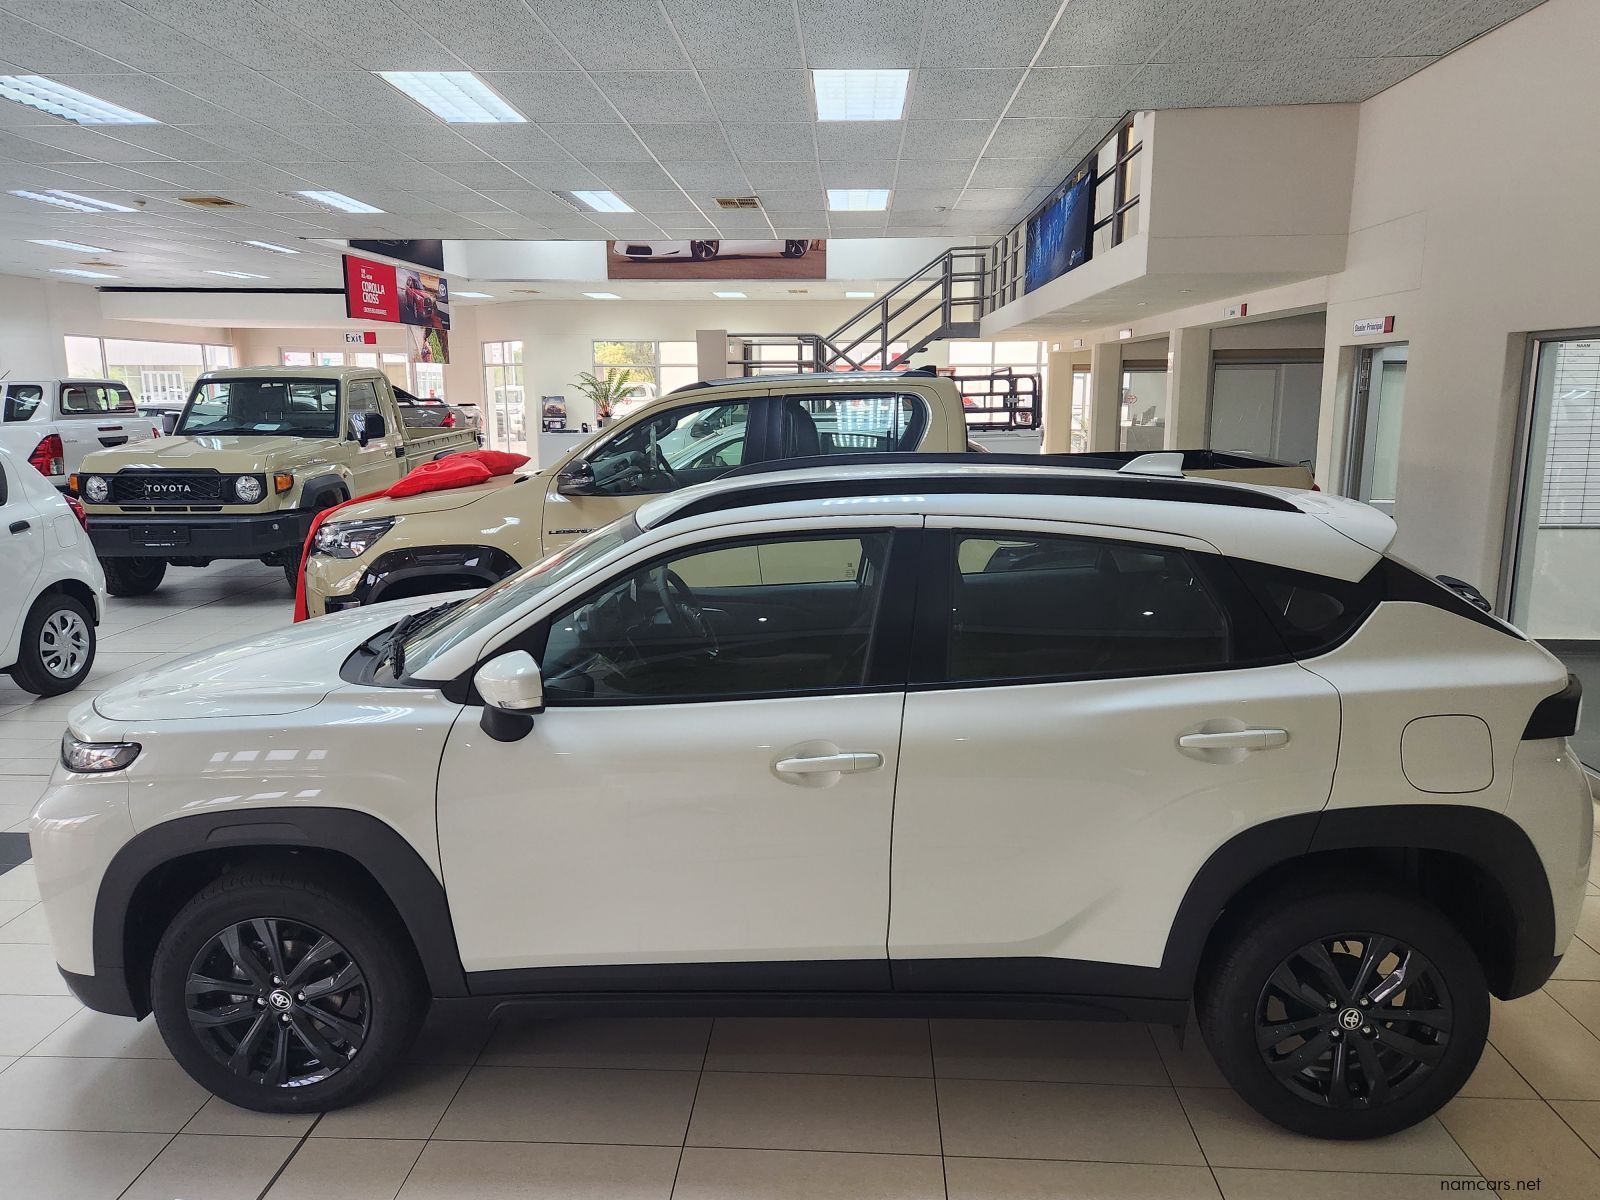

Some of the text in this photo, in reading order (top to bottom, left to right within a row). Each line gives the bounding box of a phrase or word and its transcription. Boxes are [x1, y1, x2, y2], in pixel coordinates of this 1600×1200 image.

[361, 280, 385, 295] COROLLA
[362, 291, 379, 305] CROSS
[345, 333, 363, 343] Exit
[146, 484, 191, 492] TOYOTA
